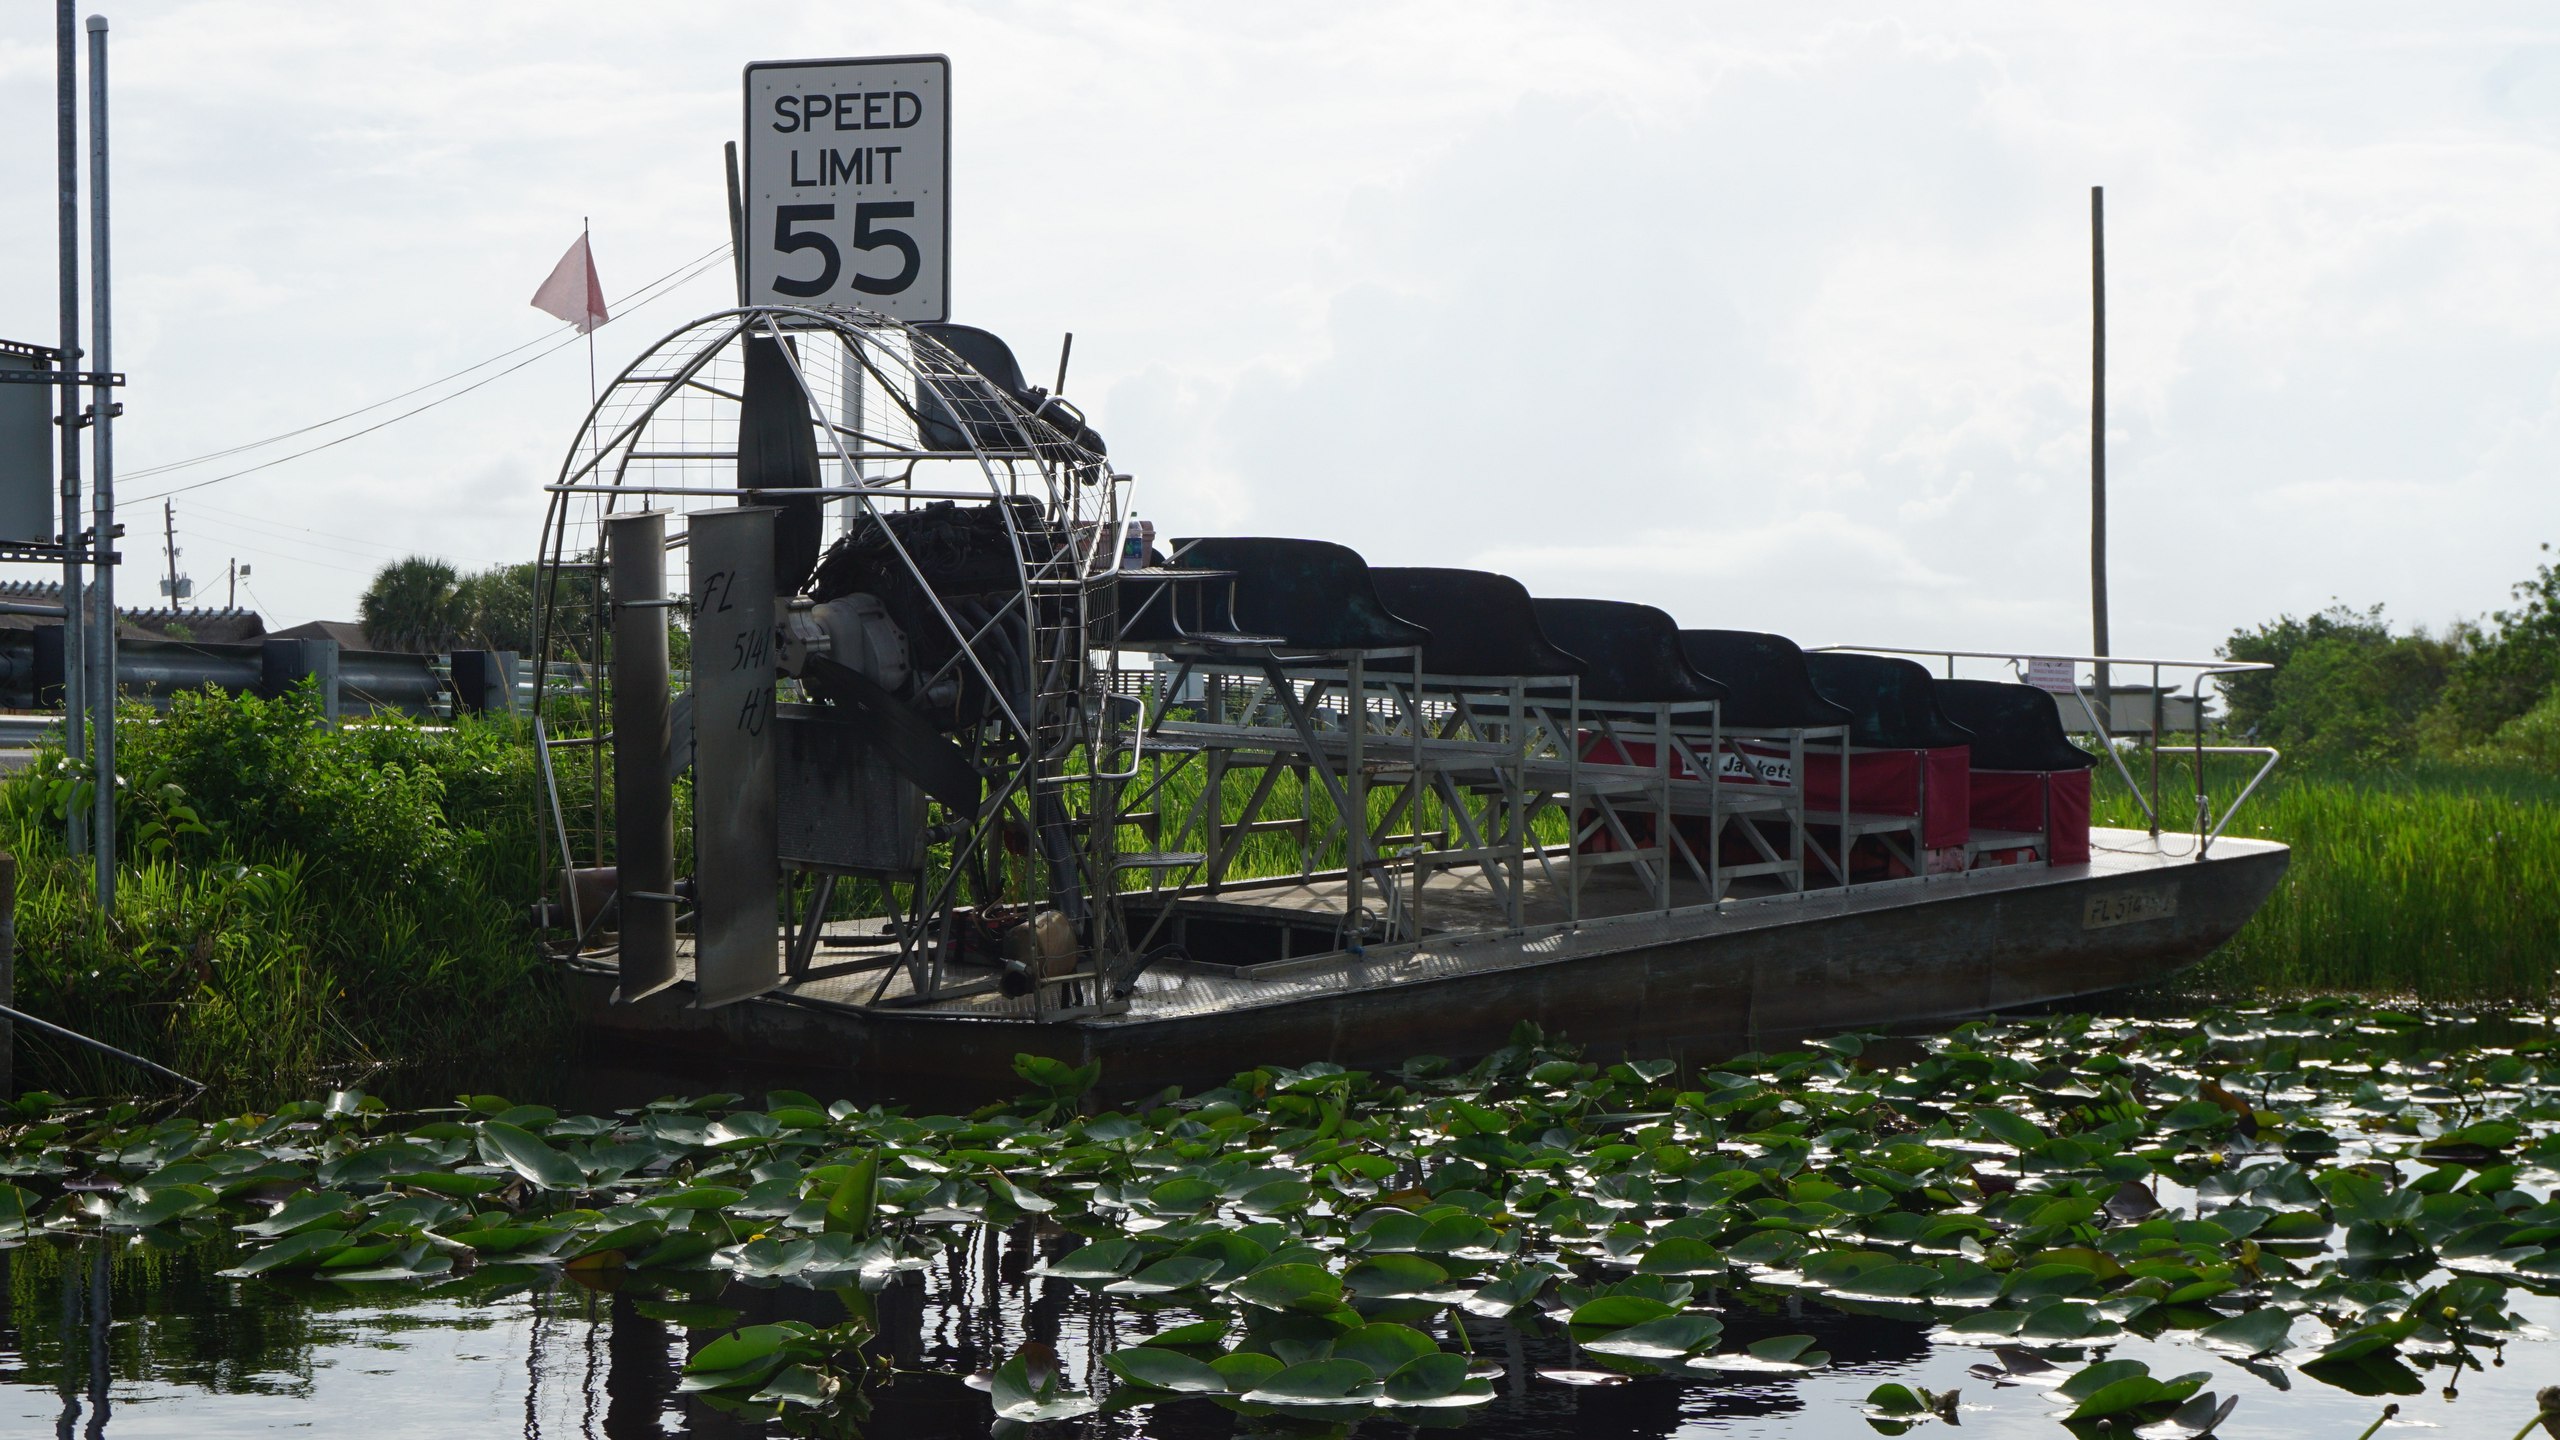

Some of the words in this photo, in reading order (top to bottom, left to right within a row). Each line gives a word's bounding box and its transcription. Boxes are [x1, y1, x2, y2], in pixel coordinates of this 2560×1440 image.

[772, 91, 922, 133] SPEED
[791, 146, 902, 187] LIMIT
[772, 201, 921, 298] 55
[700, 571, 736, 613] FL
[731, 626, 771, 672] 5141
[738, 688, 772, 737] HJ
[2091, 899, 2111, 924] FL
